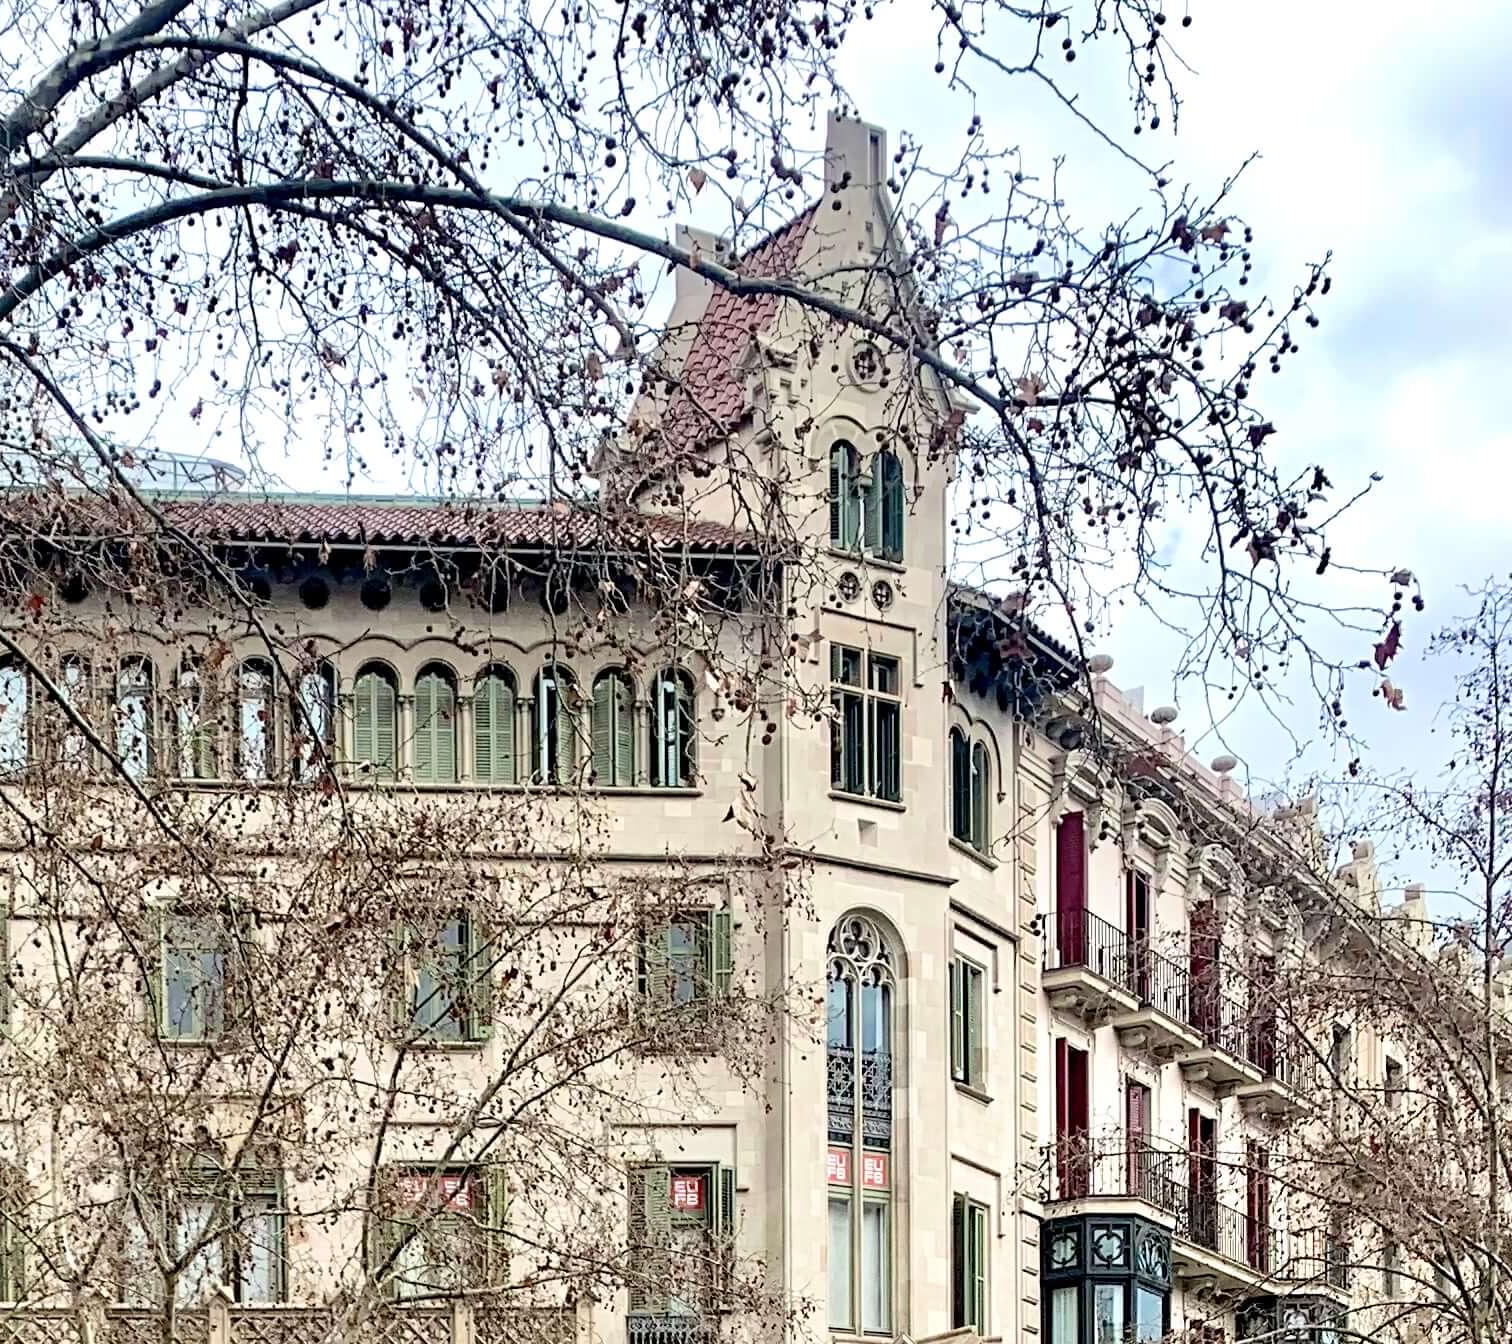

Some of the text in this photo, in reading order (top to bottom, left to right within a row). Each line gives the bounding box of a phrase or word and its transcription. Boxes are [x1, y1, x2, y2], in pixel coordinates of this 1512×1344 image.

[864, 1158, 884, 1172] EU
[864, 1171, 884, 1184] FB
[674, 1180, 699, 1193] EU
[674, 1194, 699, 1205] FB
